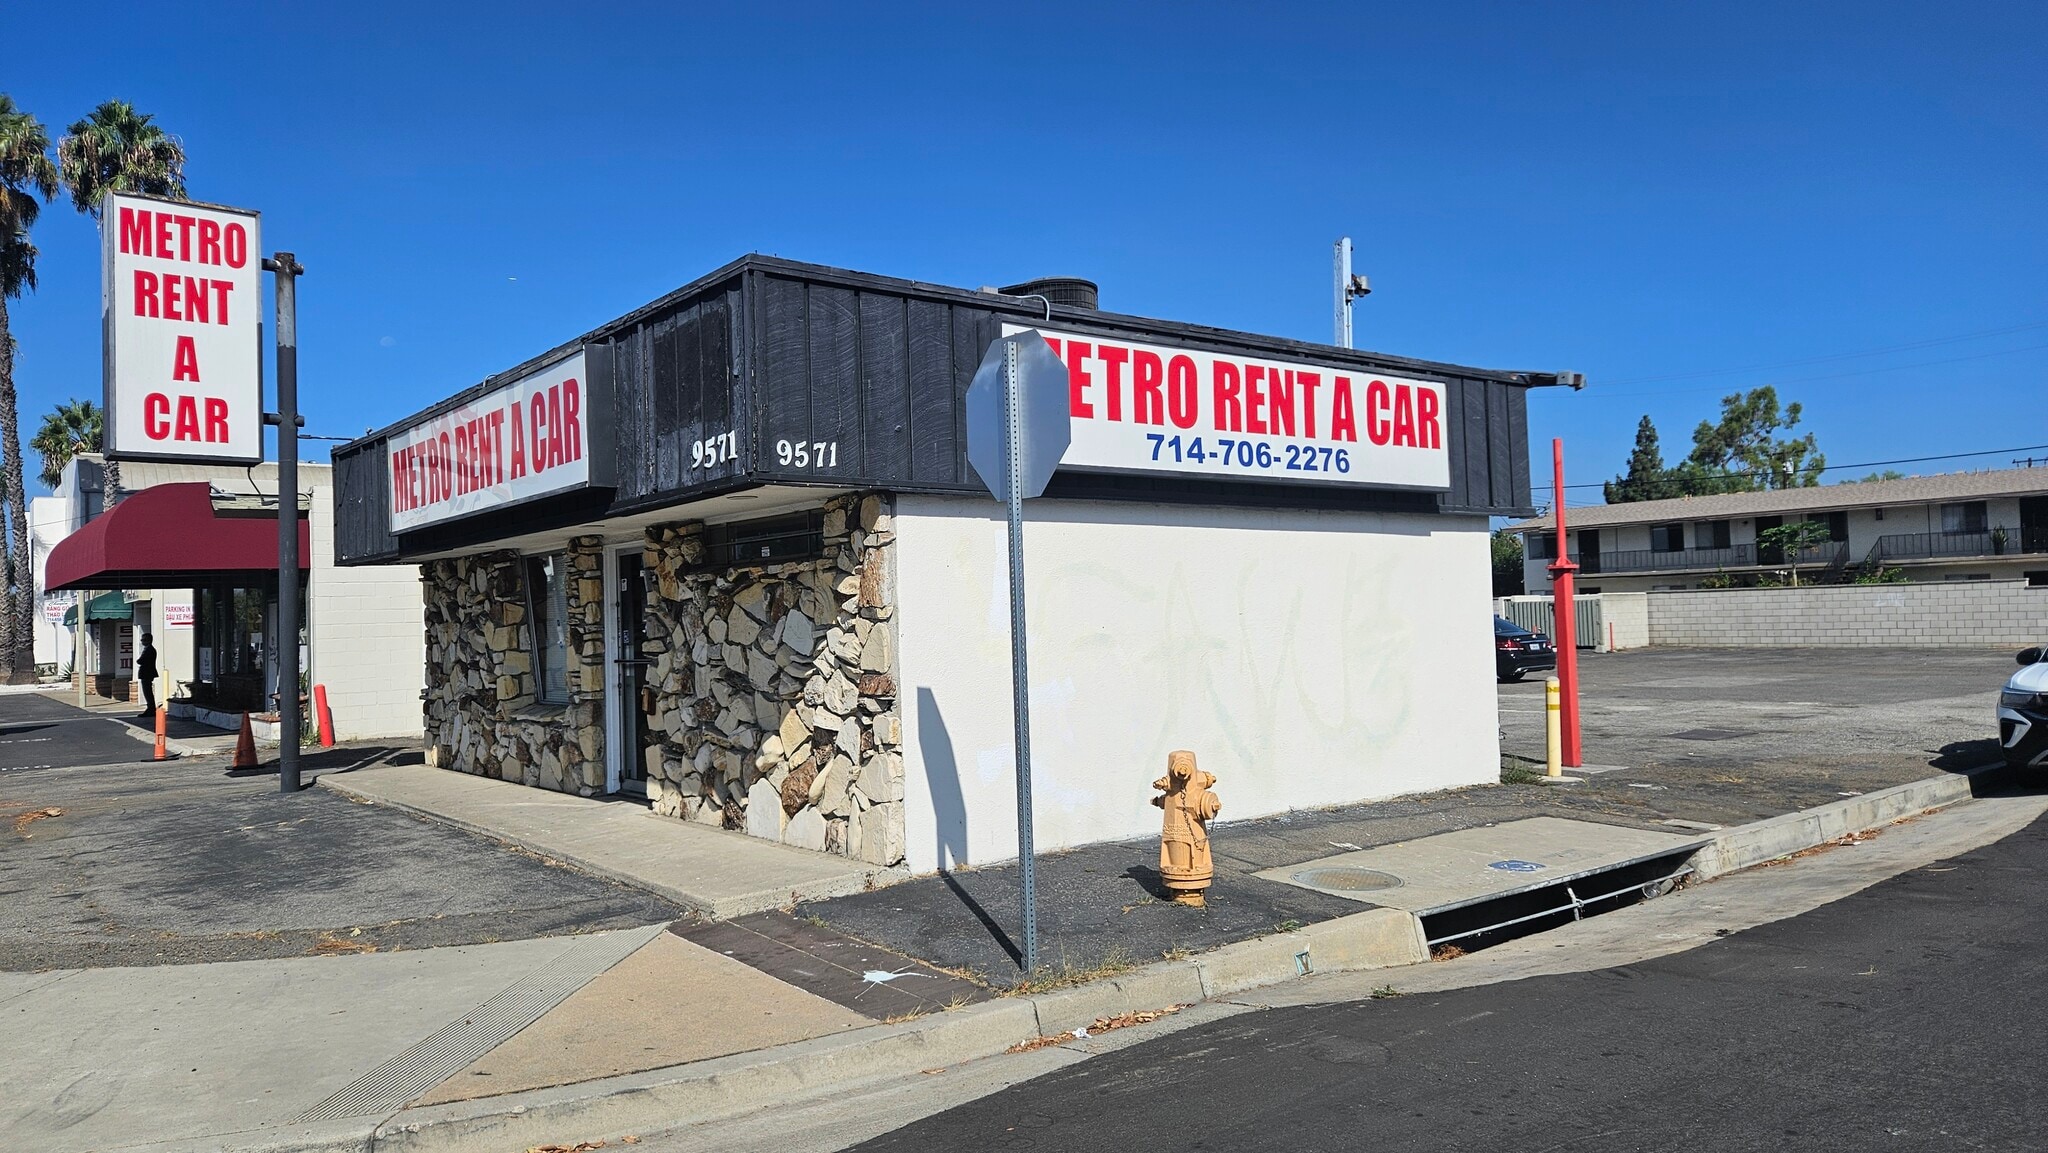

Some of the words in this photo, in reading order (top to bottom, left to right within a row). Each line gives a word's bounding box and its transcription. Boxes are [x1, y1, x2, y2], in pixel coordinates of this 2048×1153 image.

[119, 206, 248, 270] METRO
[133, 269, 235, 326] RENT
[172, 335, 201, 383] A
[143, 391, 230, 444] CAR
[1043, 336, 1198, 430] ETRO
[1212, 359, 1322, 440] RENT
[1331, 375, 1358, 443] A
[1366, 379, 1442, 450] CAR
[392, 430, 453, 514] METRO
[454, 407, 505, 497] RENT
[510, 400, 527, 481] A
[530, 377, 582, 475] CAR
[691, 429, 739, 470] 9571
[776, 438, 837, 469] 9571
[1146, 432, 1351, 474] 714-706-2276
